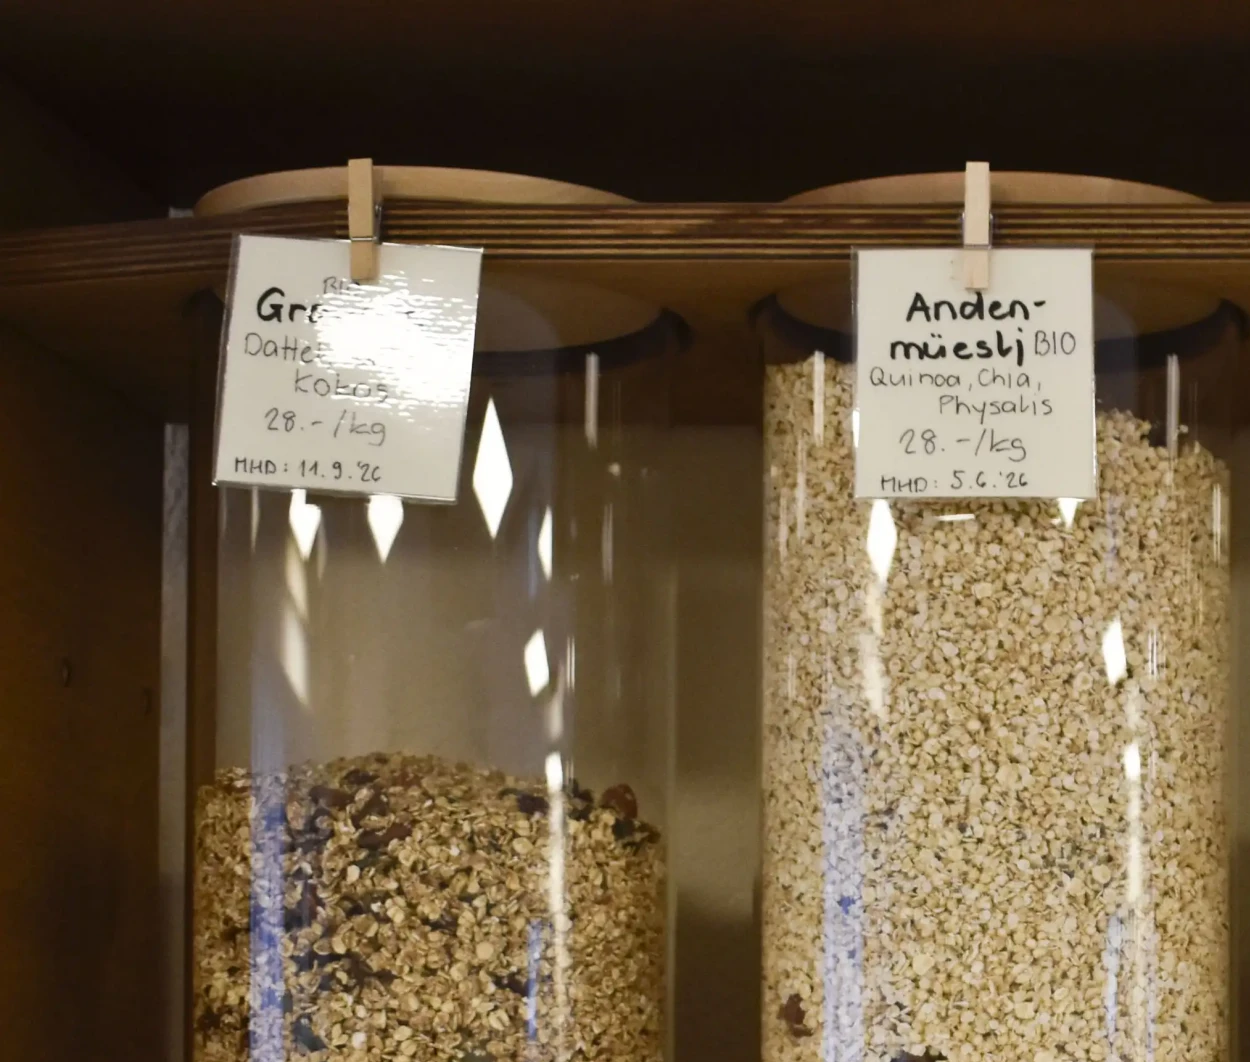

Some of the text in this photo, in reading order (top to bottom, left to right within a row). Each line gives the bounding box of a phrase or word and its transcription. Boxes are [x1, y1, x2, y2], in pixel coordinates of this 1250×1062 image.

[906, 291, 1047, 322] Anden-
[1034, 330, 1077, 356] BIO
[869, 366, 973, 392] Quinoa,
[939, 393, 1053, 425] Physalis
